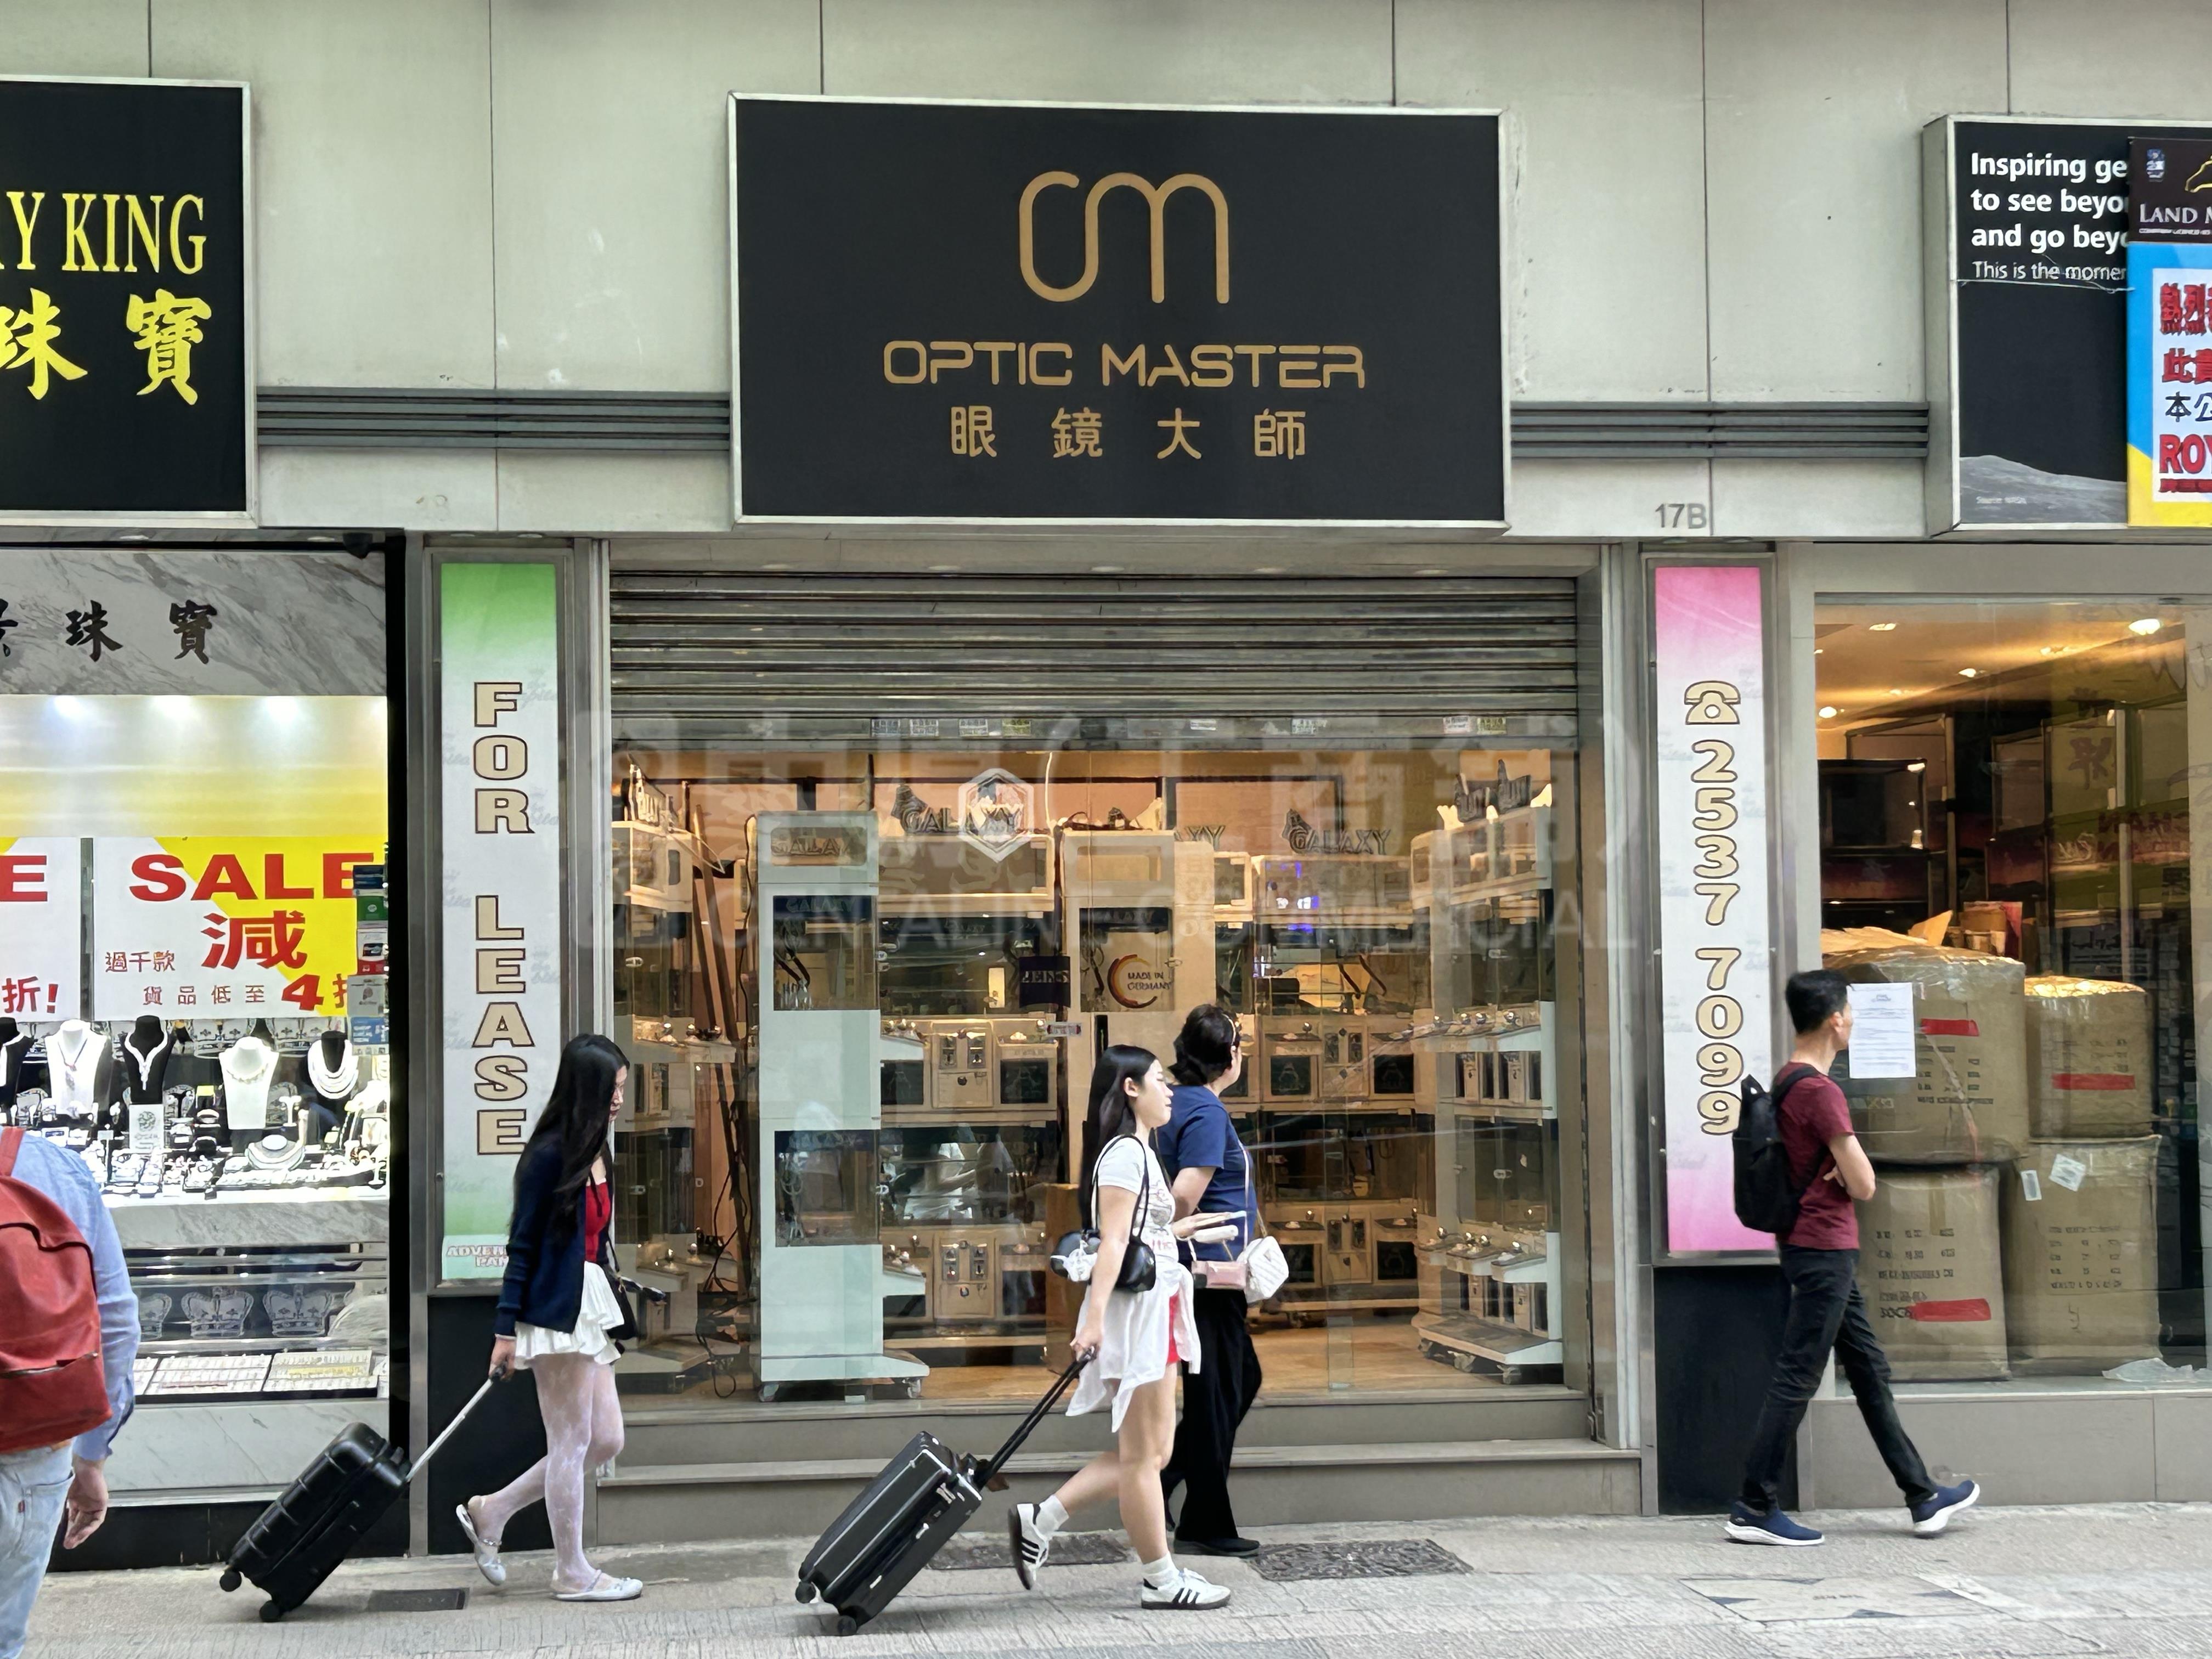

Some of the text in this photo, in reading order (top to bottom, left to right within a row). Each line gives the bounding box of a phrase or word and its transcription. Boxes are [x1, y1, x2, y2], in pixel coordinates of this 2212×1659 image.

[1971, 152, 2086, 184] Inspiring
[1970, 188, 2129, 219] to see beyo
[2140, 203, 2198, 224] LAND
[0, 191, 207, 275] Y KING
[1971, 223, 2022, 247] and
[2030, 229, 2065, 256] go
[1972, 260, 2008, 279] This
[2013, 262, 2027, 279] is
[2030, 261, 2061, 280] the
[2160, 283, 2212, 336] 熱烈
[0, 288, 212, 405] 珠寶
[883, 340, 1365, 389] OPTIC MASTER
[951, 405, 1305, 459] 眼鏡大師
[1655, 503, 1707, 529] 17B
[1289, 827, 1392, 855] GALAXY
[129, 853, 374, 901] SALE
[201, 910, 307, 969] 減
[472, 681, 535, 1155] FOR LEASE
[1690, 739, 1744, 1136] 2537 7099
[105, 950, 176, 973] 過千款
